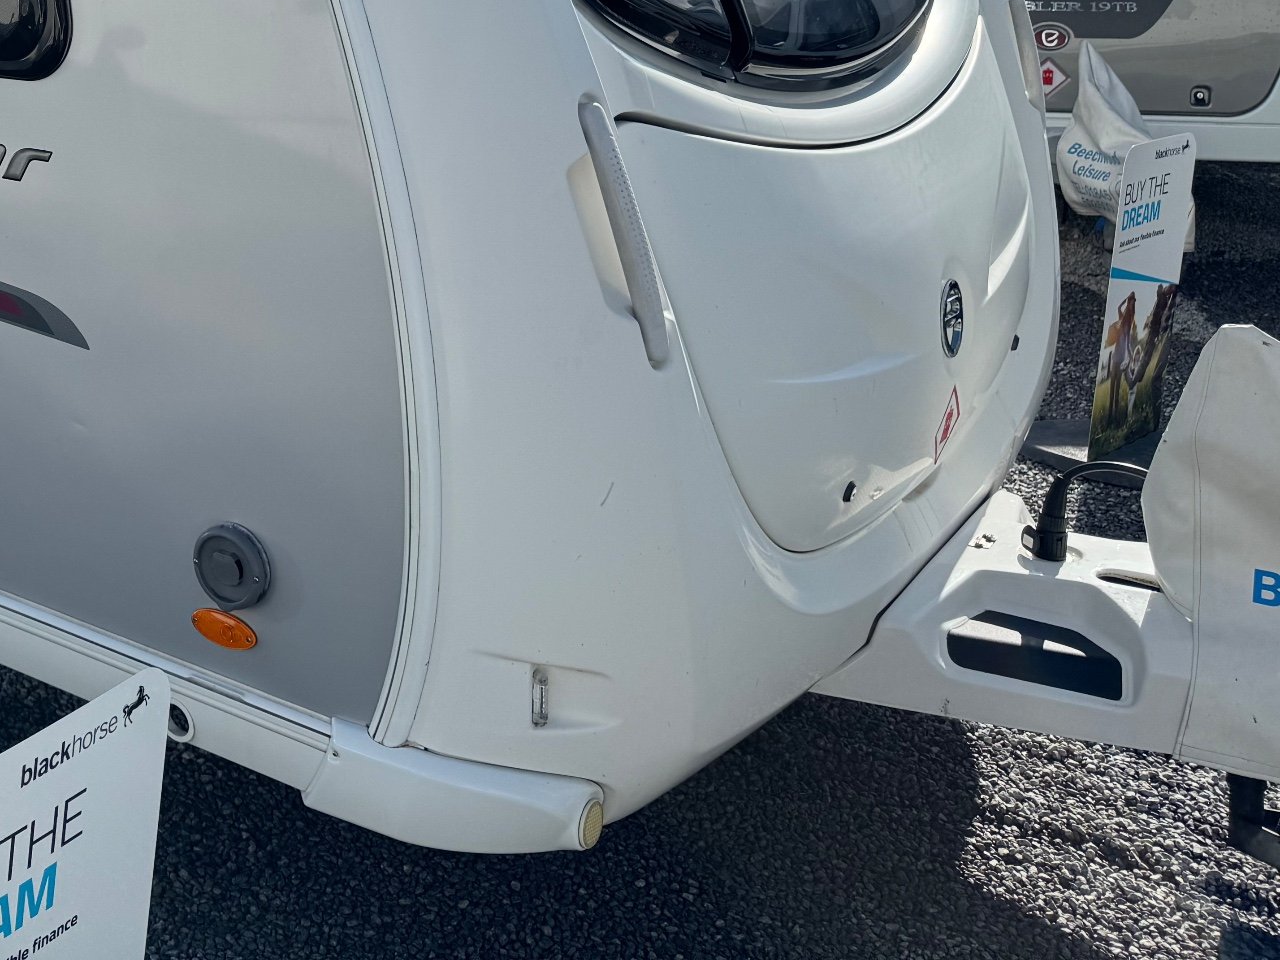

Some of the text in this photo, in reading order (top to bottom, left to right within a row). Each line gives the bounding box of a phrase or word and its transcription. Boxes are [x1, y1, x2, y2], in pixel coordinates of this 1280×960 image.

[1089, 0, 1138, 13] 19TB
[1072, 159, 1111, 182] Leisure
[1124, 178, 1148, 206] BUY
[1149, 172, 1171, 199] THE
[1121, 199, 1162, 232] DREAM
[20, 714, 118, 789] blackhorse
[0, 787, 88, 882] THE
[32, 914, 78, 954] finance
